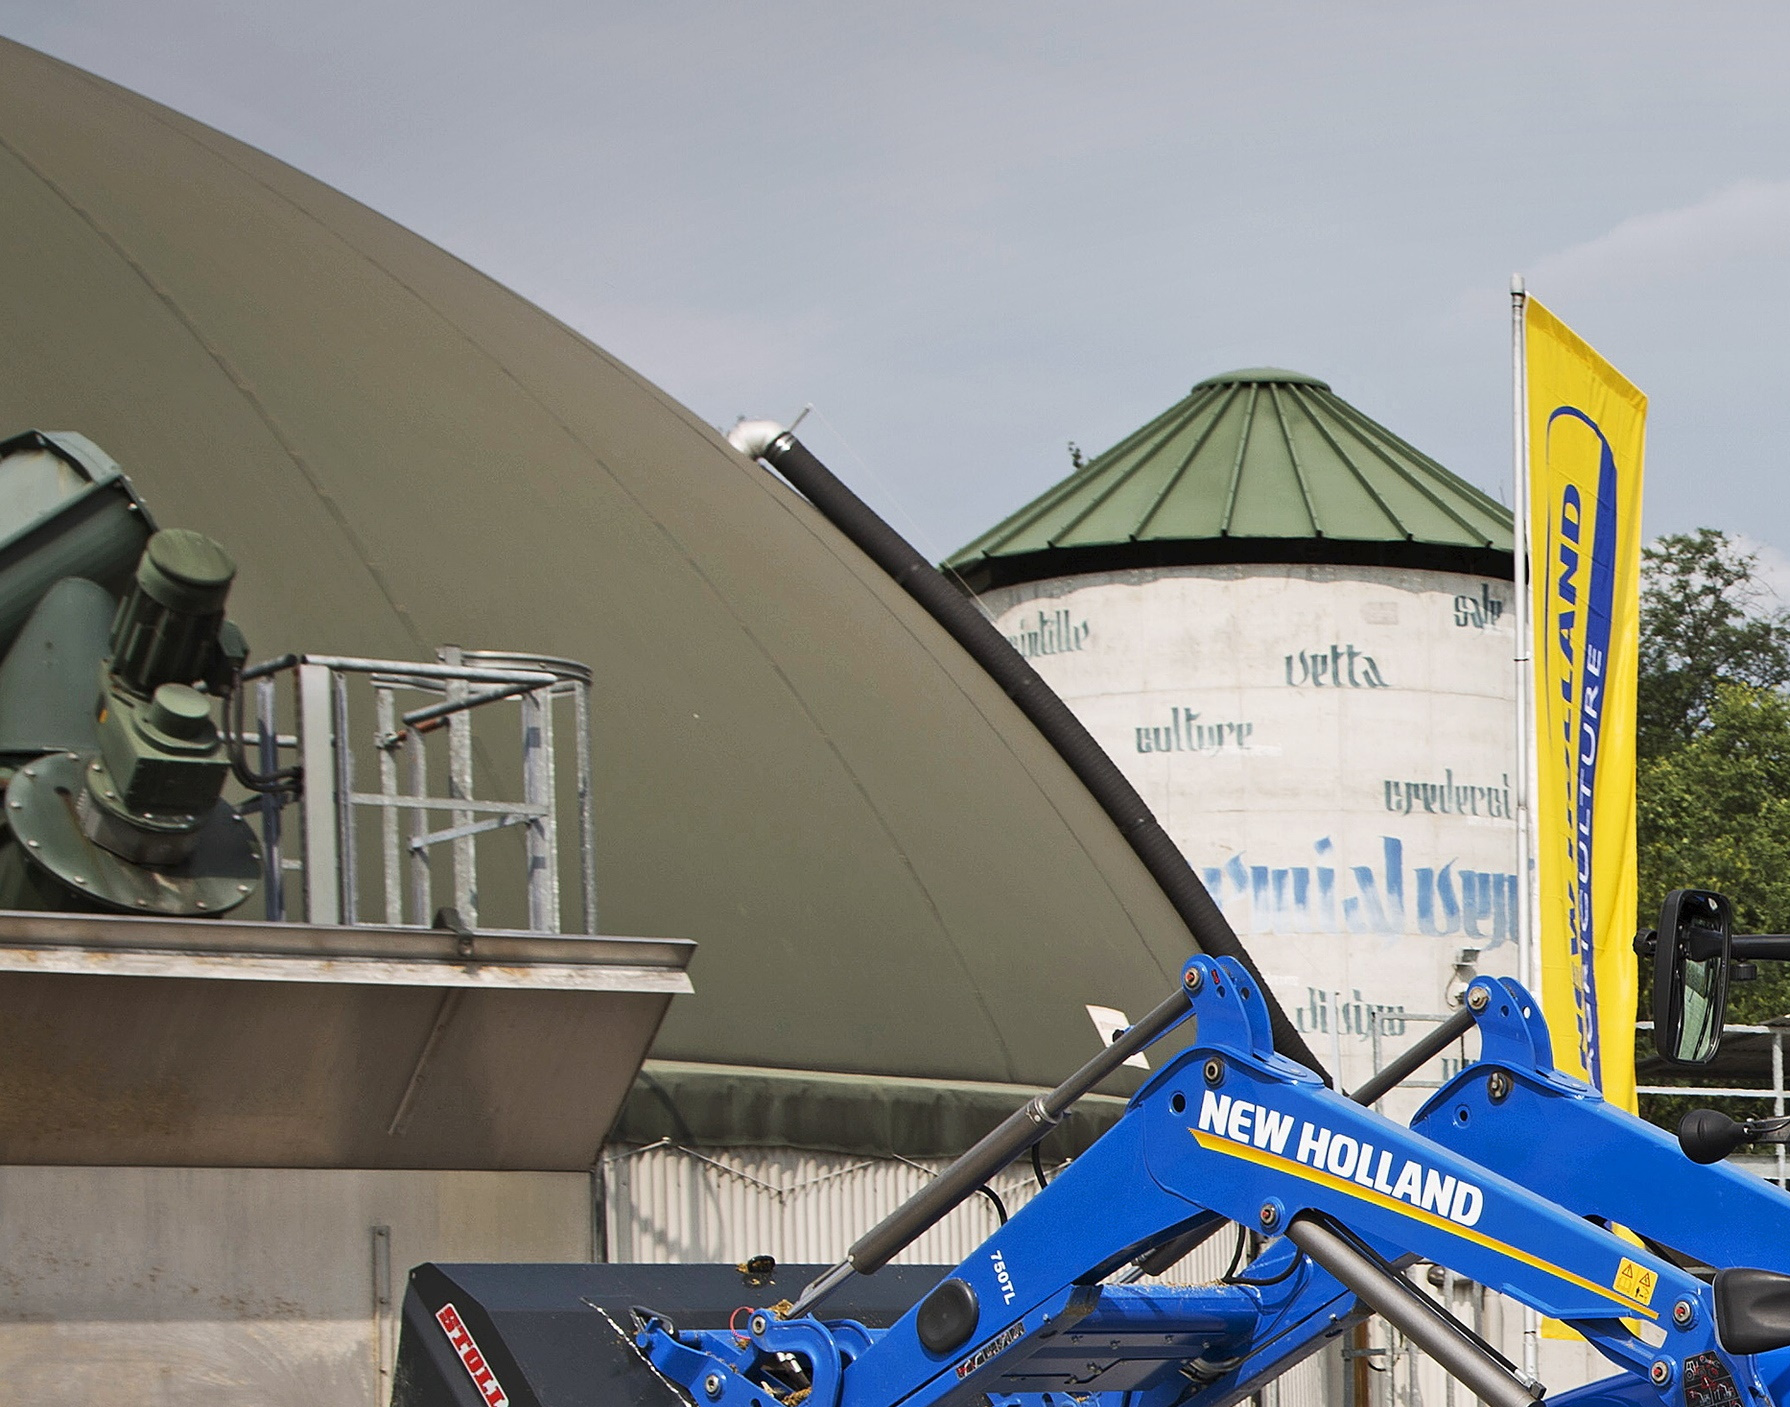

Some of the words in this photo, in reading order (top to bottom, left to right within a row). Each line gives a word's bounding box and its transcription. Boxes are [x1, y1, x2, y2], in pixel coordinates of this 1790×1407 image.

[1285, 644, 1392, 688] vetta
[1135, 706, 1253, 755] culture
[1199, 1090, 1294, 1154] NEW
[1296, 1121, 1484, 1227] HOLLAND
[990, 1250, 1016, 1305] 750TL
